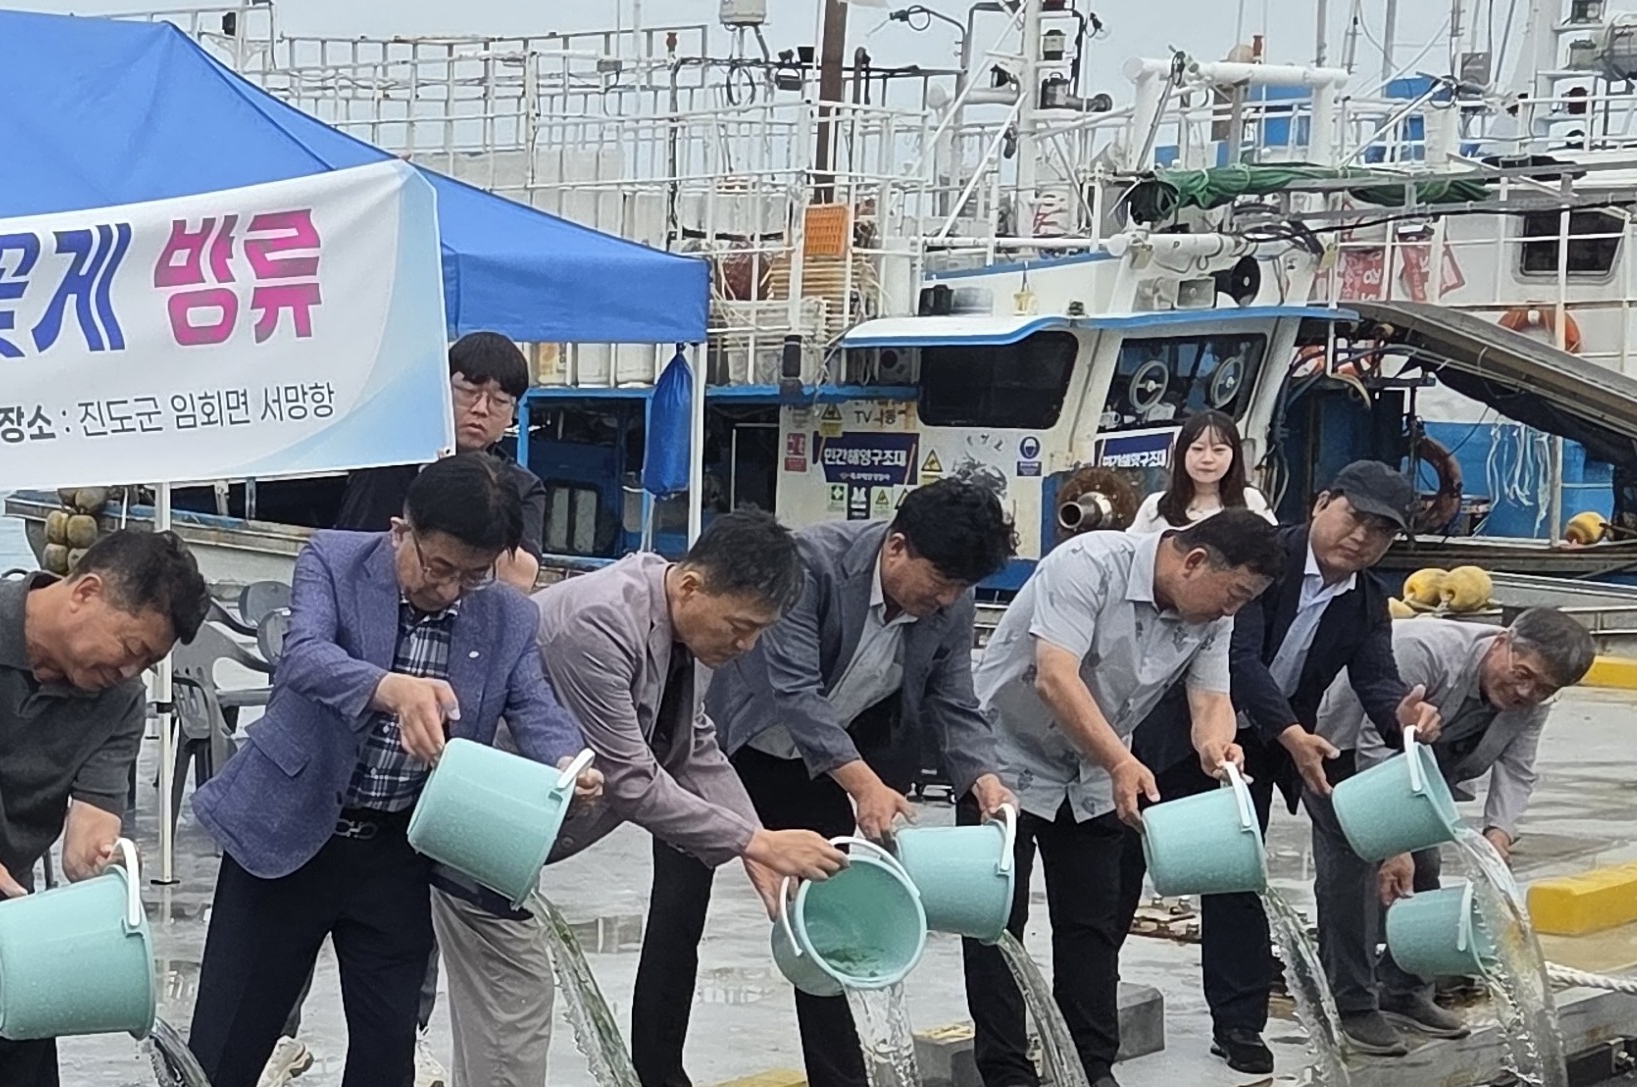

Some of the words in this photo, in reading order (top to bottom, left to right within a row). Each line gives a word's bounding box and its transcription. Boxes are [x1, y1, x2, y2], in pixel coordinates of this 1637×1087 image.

[154, 208, 322, 346] 방류
[77, 397, 164, 437] 진도군
[170, 388, 251, 430] 임회면
[260, 382, 335, 422] 서망항
[823, 447, 907, 467] 민간해양구조대
